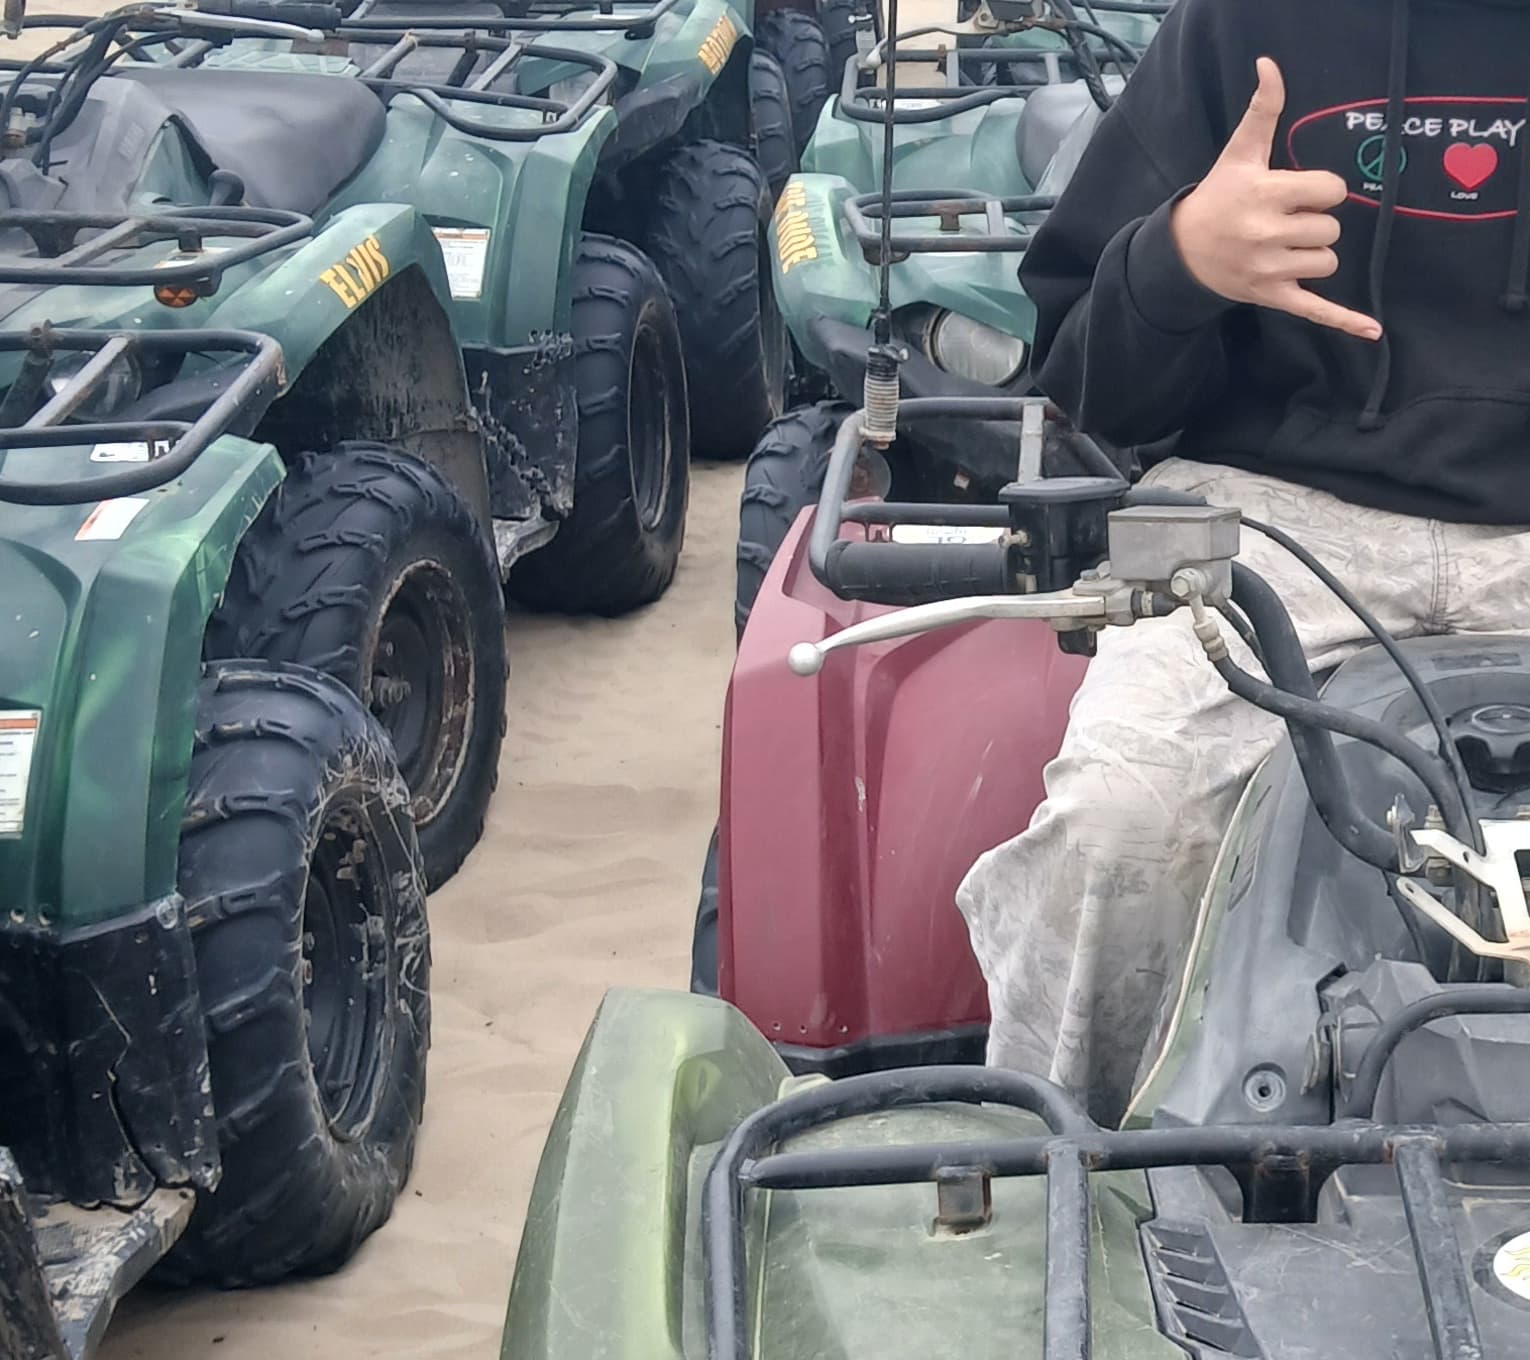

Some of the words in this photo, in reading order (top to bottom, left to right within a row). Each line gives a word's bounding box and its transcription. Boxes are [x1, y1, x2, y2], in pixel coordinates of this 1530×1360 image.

[1344, 111, 1443, 136] PECE
[1450, 191, 1479, 200] LOVE
[319, 234, 391, 309] ELVIS
